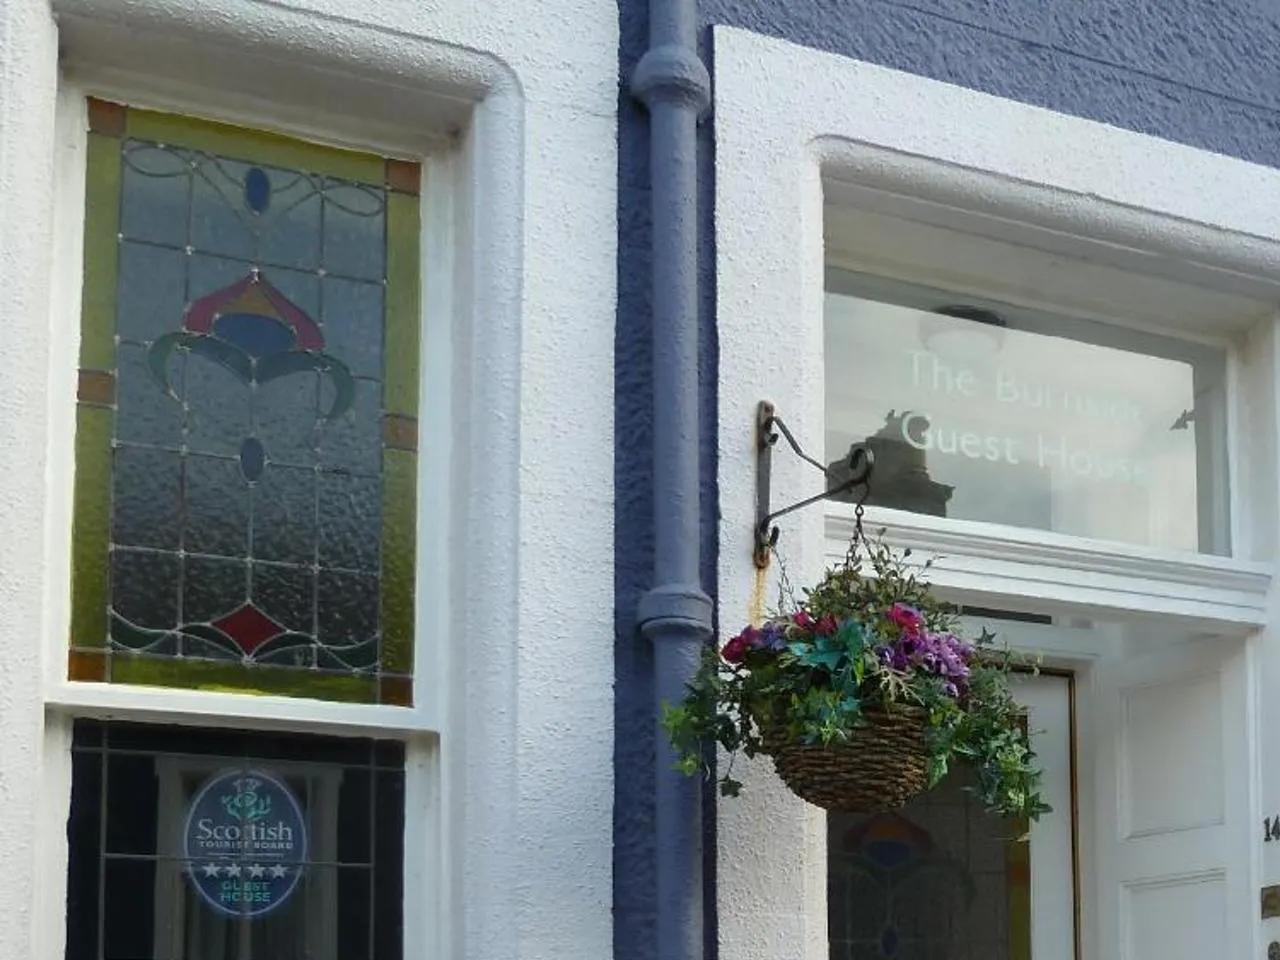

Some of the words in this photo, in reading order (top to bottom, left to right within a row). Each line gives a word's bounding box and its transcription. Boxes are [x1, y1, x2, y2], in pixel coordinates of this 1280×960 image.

[902, 348, 977, 397] The
[901, 408, 1020, 466] Guest
[1263, 814, 1280, 842] 14
